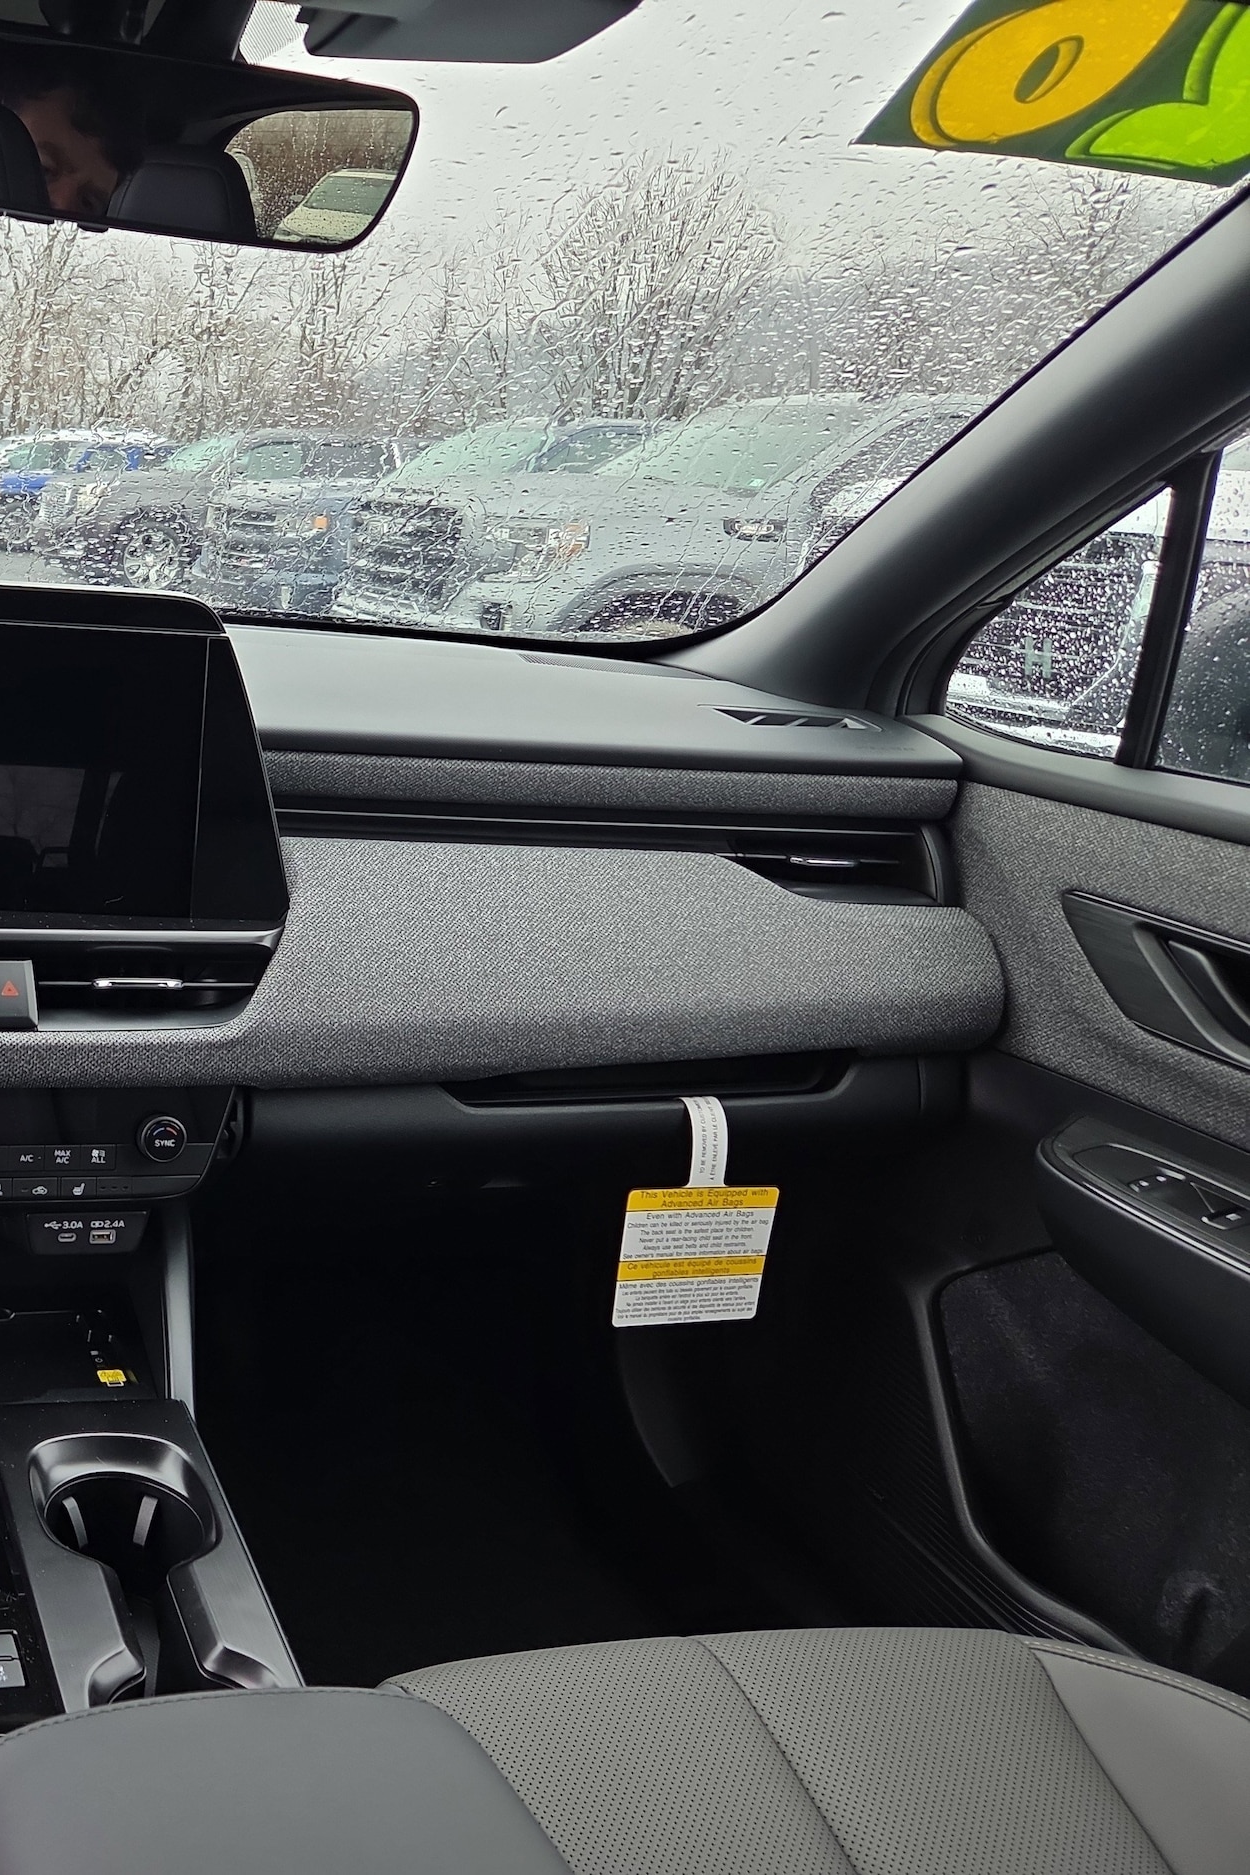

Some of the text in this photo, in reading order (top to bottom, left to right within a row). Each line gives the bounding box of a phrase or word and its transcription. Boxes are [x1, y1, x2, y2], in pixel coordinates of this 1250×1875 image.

[154, 1139, 176, 1147] SYNC
[19, 1154, 34, 1163] A/C
[707, 1189, 748, 1198] Equipped
[62, 1221, 83, 1229] 3.0A
[103, 1220, 125, 1228] 2.4A
